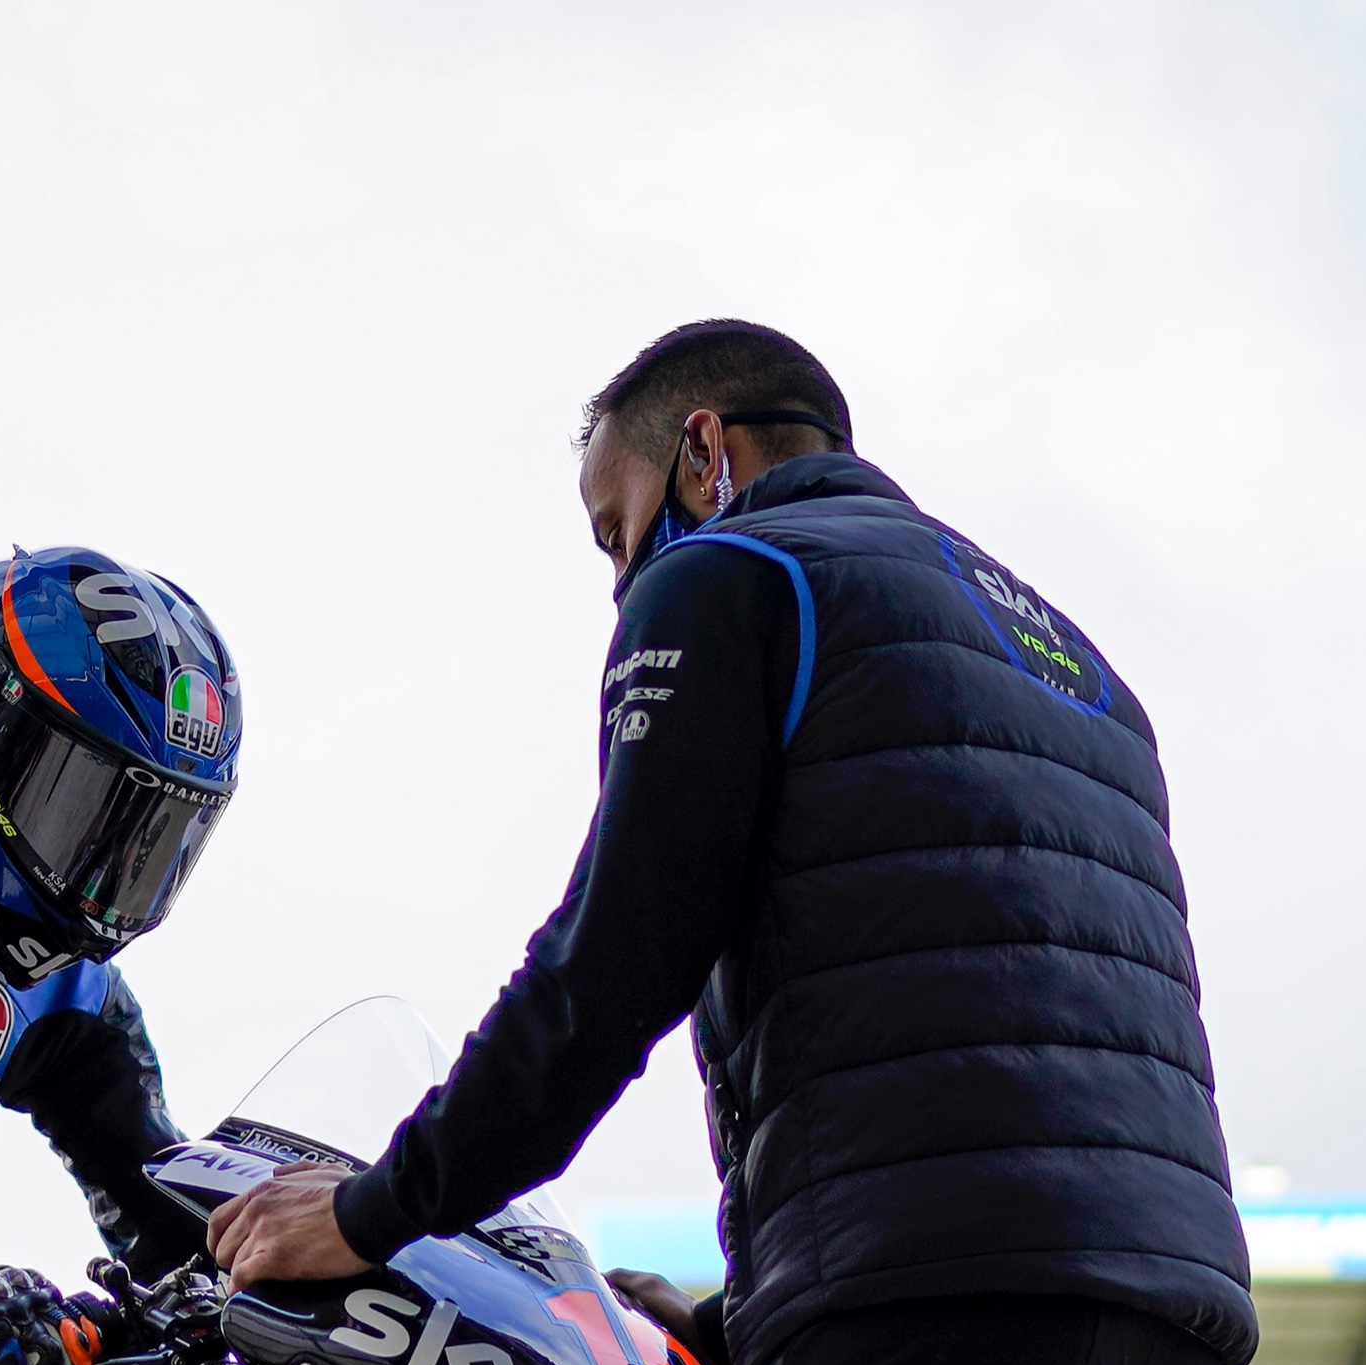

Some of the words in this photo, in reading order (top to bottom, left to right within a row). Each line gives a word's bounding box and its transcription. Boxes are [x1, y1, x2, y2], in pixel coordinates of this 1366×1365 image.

[973, 568, 1062, 647] sky
[604, 650, 683, 692] DUCATI
[1043, 672, 1076, 698] TEAM
[606, 687, 675, 727] DAESE
[172, 712, 218, 752] agv
[32, 866, 45, 880] New
[43, 877, 60, 896] Cities
[48, 869, 67, 892] KSA
